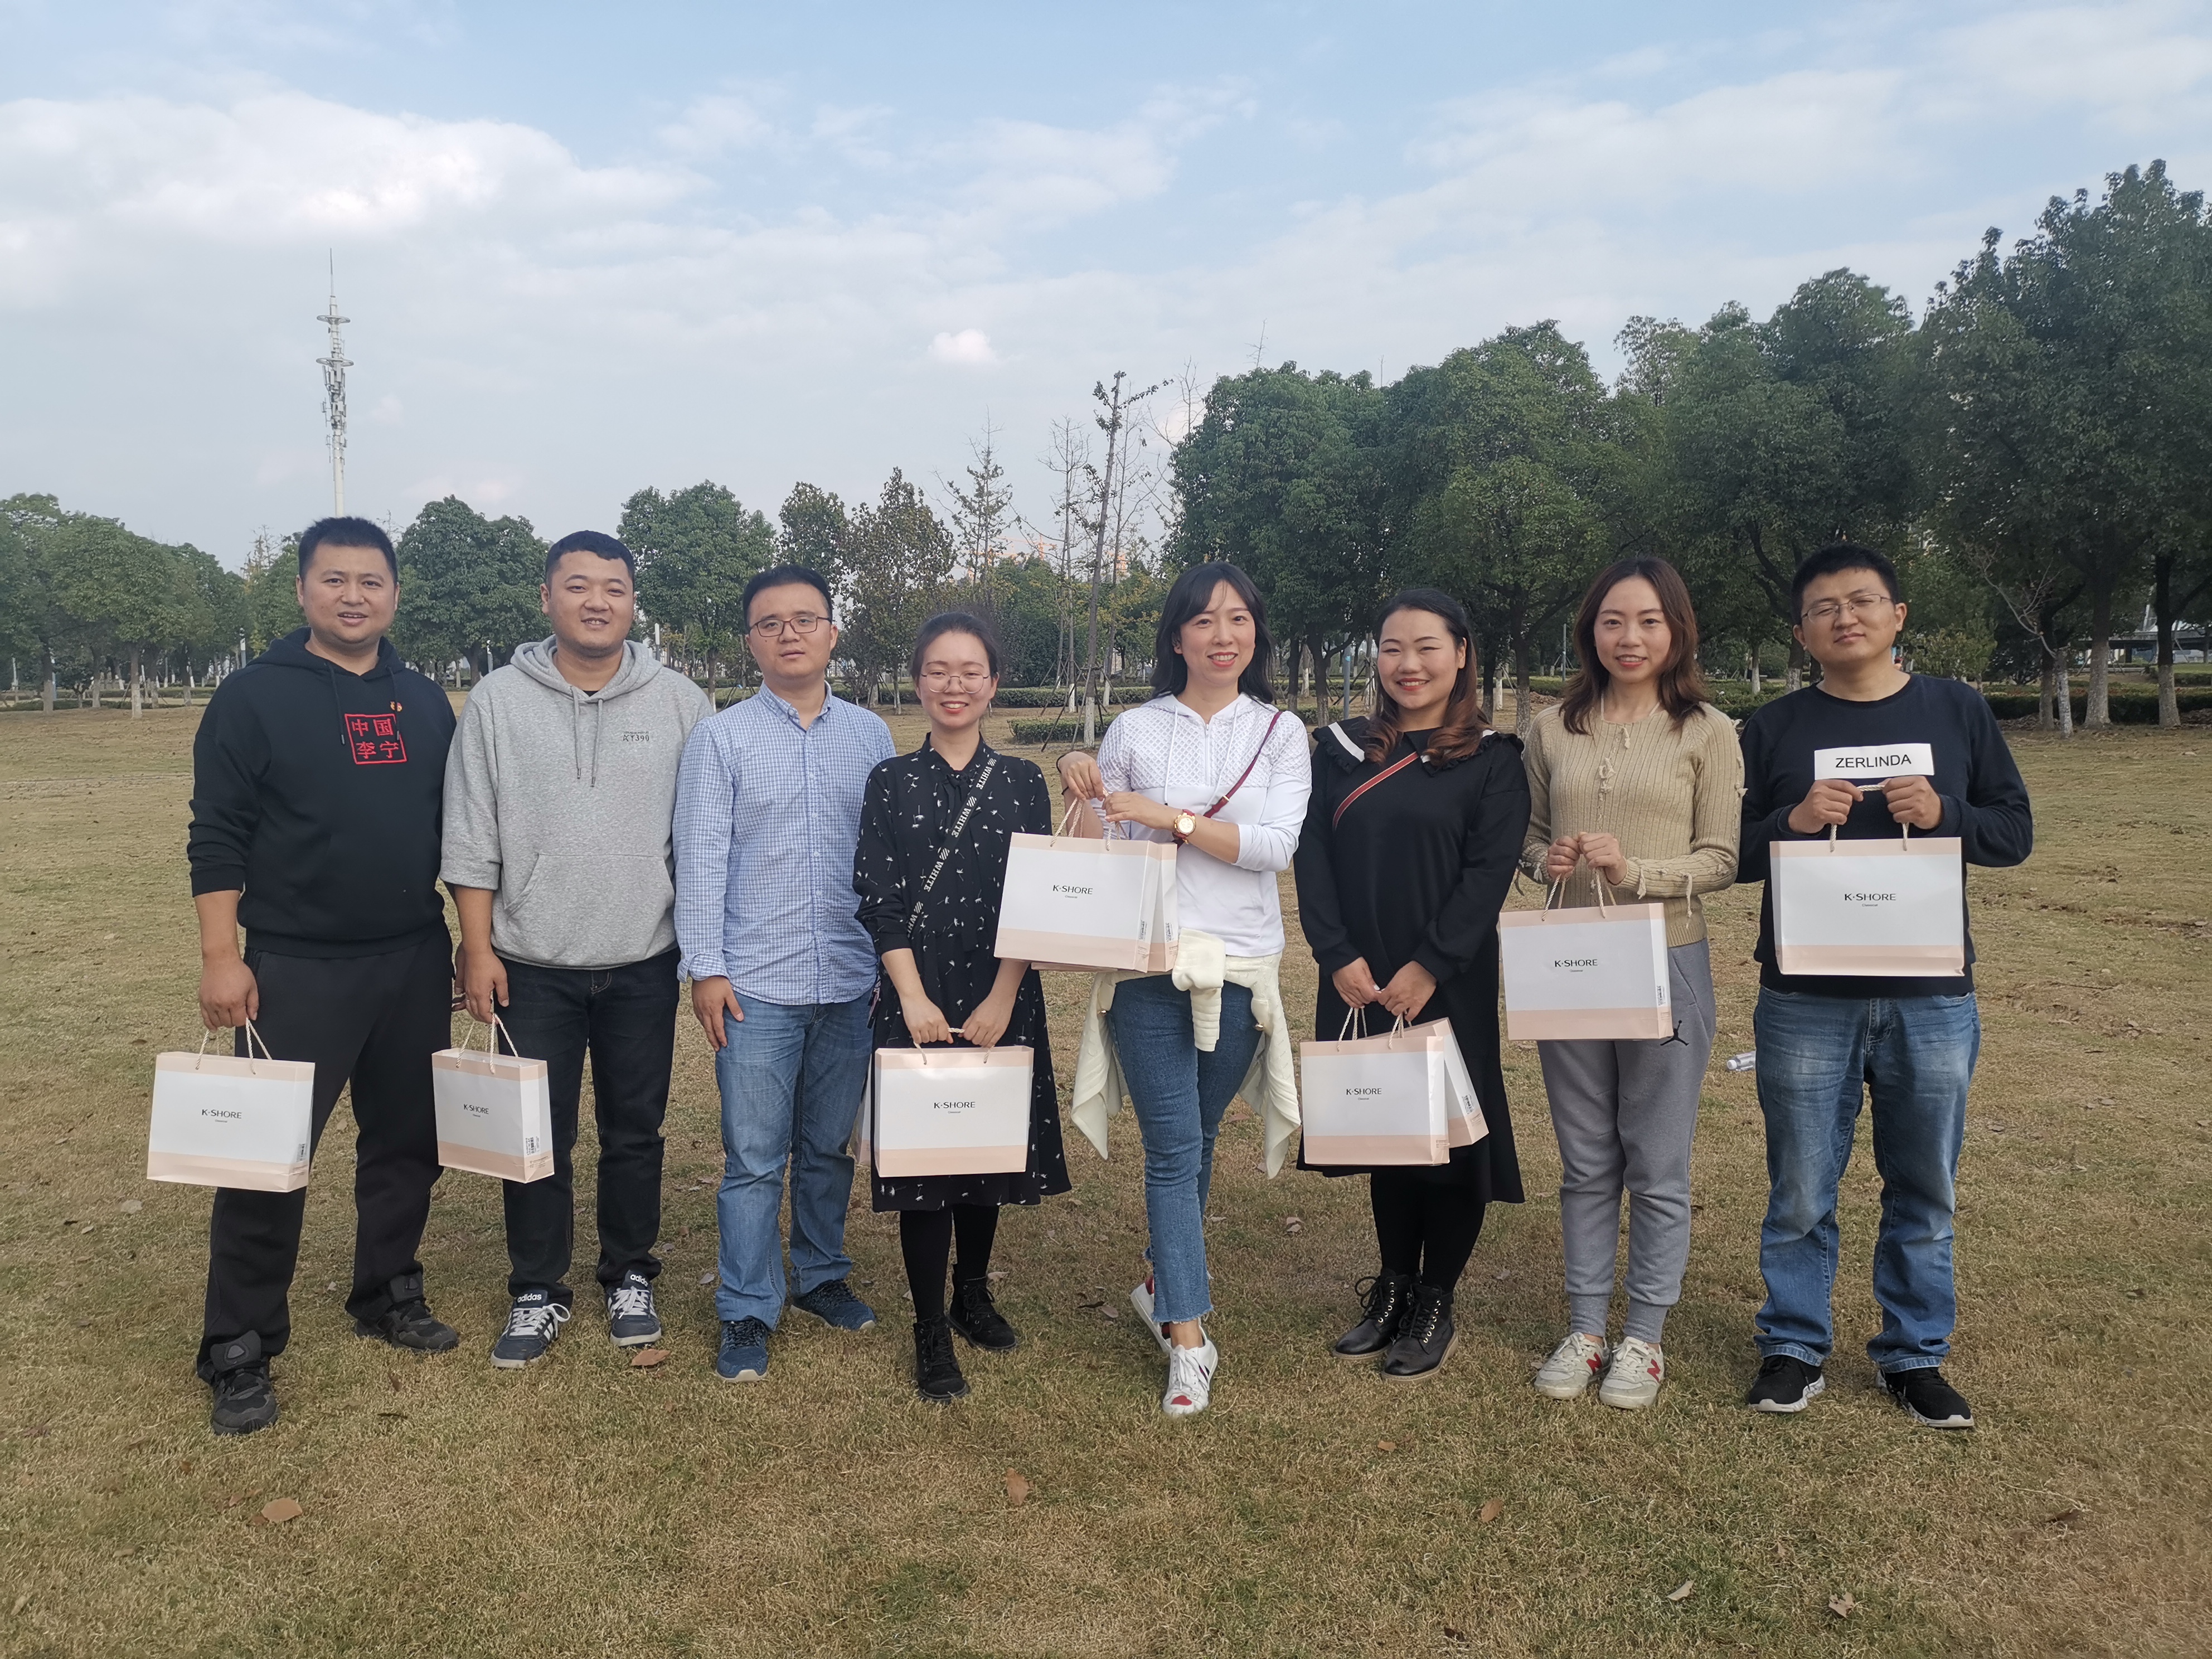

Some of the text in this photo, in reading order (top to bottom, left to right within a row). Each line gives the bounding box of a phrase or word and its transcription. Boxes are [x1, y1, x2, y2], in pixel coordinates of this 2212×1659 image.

[351, 718, 394, 737] 中国
[355, 740, 400, 760] 李宁
[1835, 754, 1912, 768] ZERLINDA
[976, 764, 993, 790] WHITE
[951, 807, 971, 838] WHITE
[923, 860, 944, 892] WHITE
[517, 1293, 542, 1303] adidas
